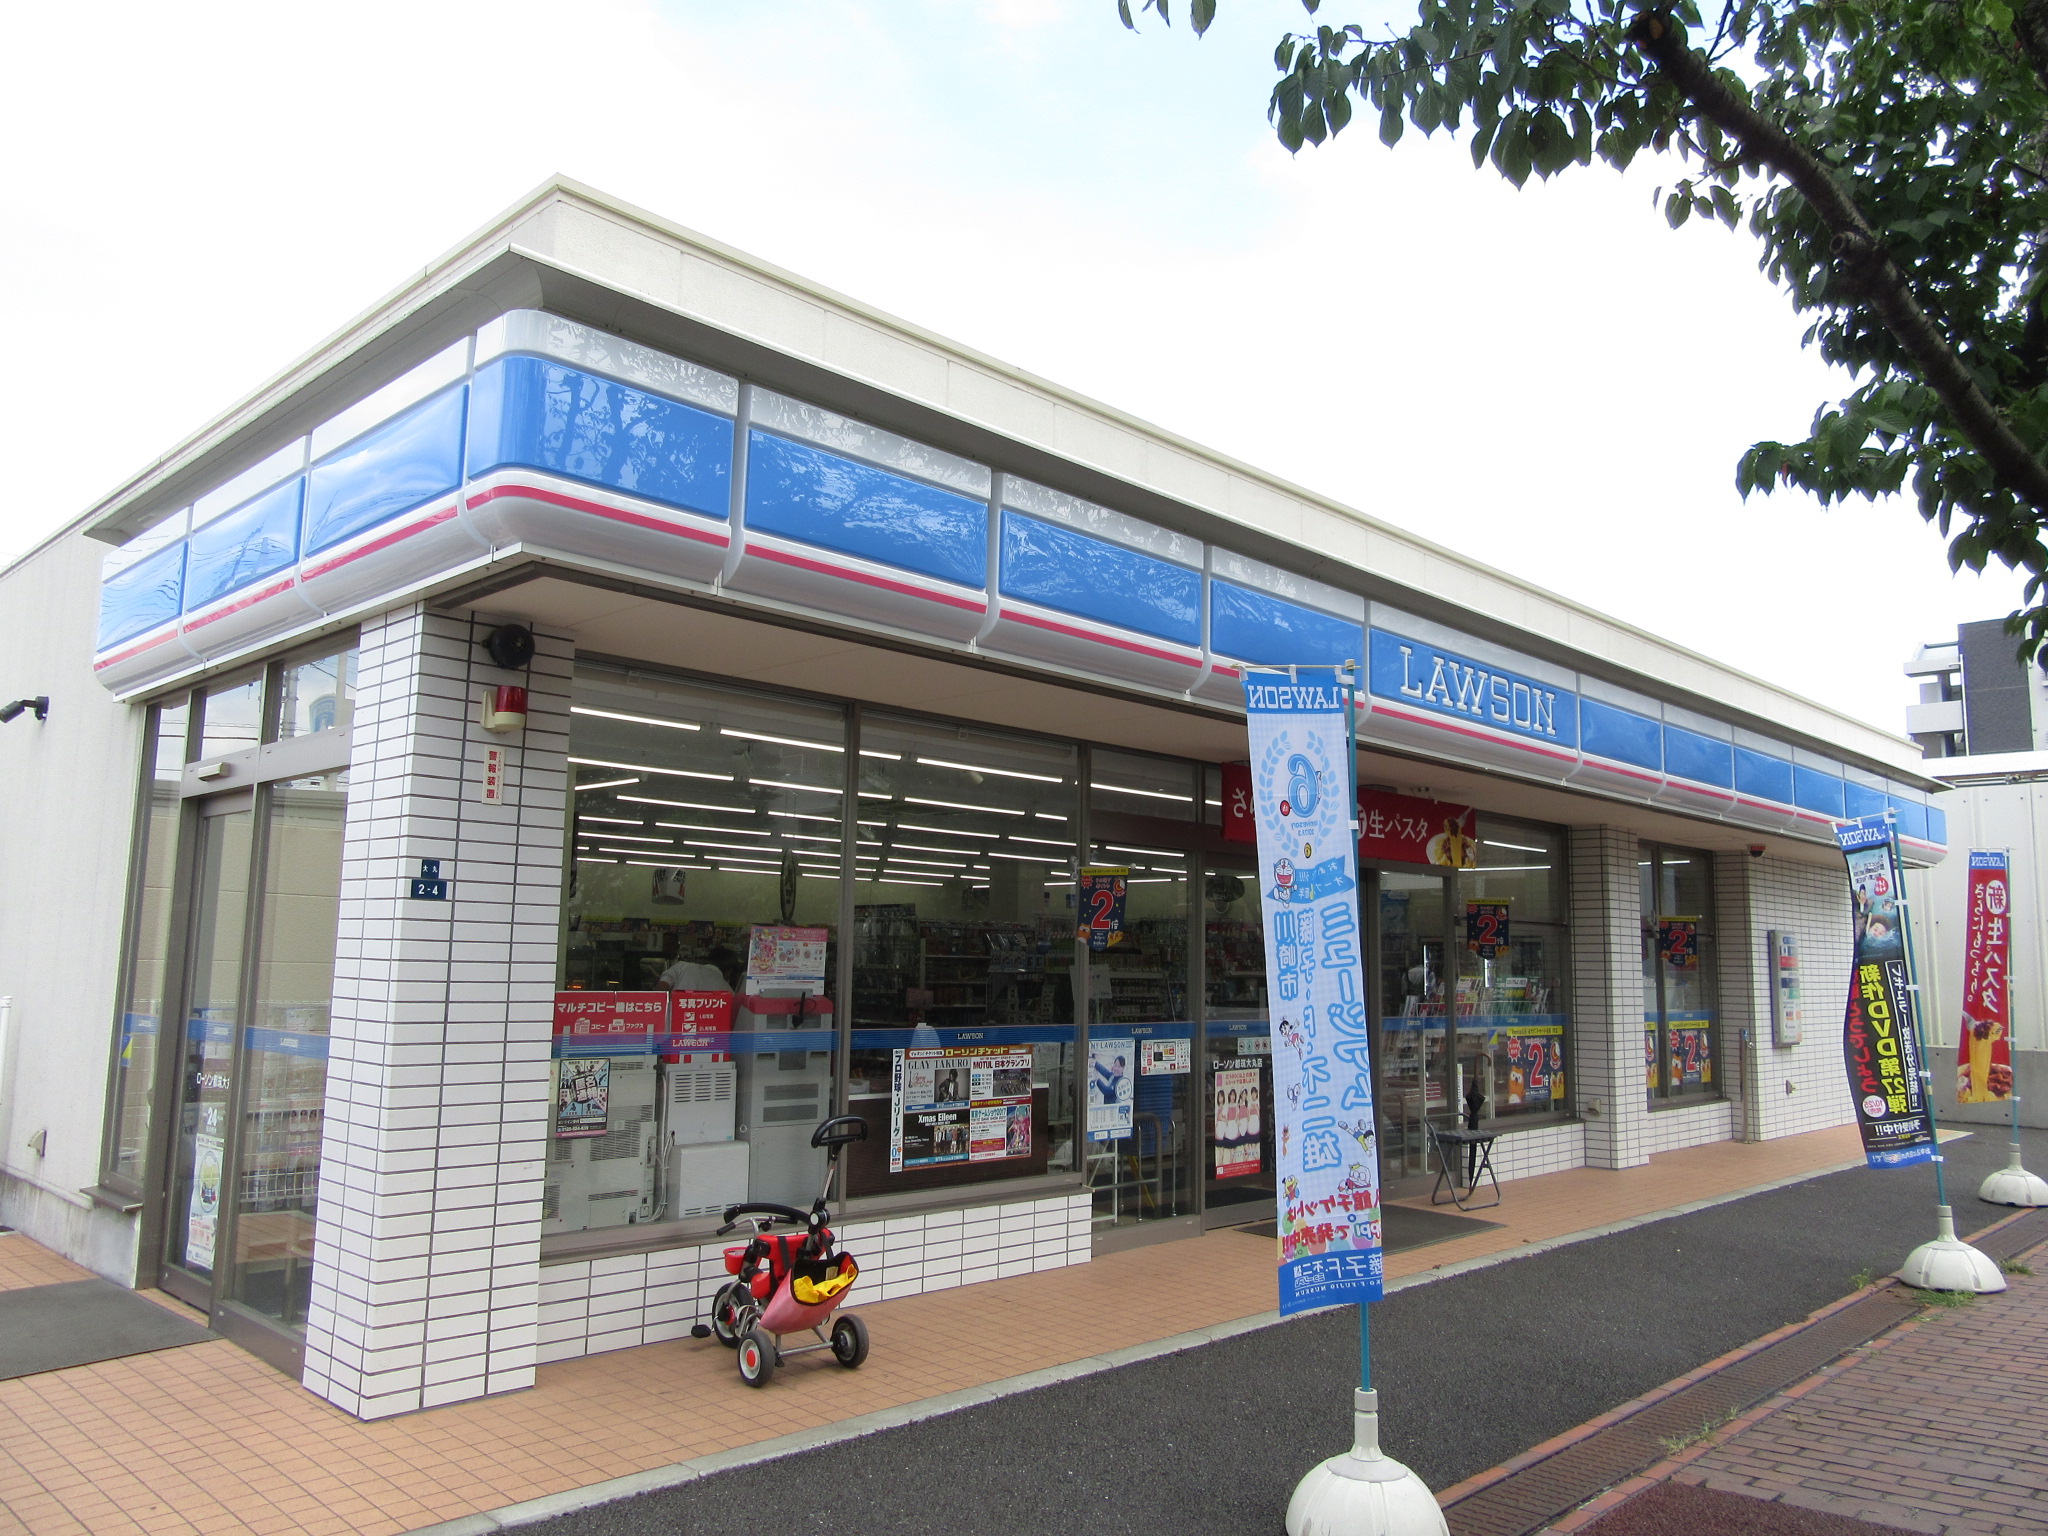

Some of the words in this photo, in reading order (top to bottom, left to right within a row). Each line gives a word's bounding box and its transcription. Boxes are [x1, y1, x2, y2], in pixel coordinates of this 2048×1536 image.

[1400, 645, 1556, 736] LAWSON
[486, 750, 498, 799] 警報装置
[1369, 808, 1430, 843] 生パスタ
[418, 884, 439, 896] 2-4
[557, 1001, 662, 1013] マルチコピー機はこちら
[678, 998, 727, 1009] 写真プリント
[957, 1032, 984, 1040] LAWSON
[1100, 1041, 1126, 1049] LAWSON
[945, 1047, 1008, 1057] ローソンチケット
[908, 1060, 931, 1070] GLAY
[934, 1058, 969, 1069] TAKURO
[973, 1061, 993, 1069] MOTUL
[995, 1059, 1030, 1068] 日本グランプリ
[1213, 1058, 1263, 1070] ローソン都筑大丸店
[893, 1055, 903, 1137] プロ野球・Jリーグ
[207, 1106, 218, 1126] 24
[918, 1114, 937, 1124] Xmas
[937, 1112, 957, 1122] Eileen
